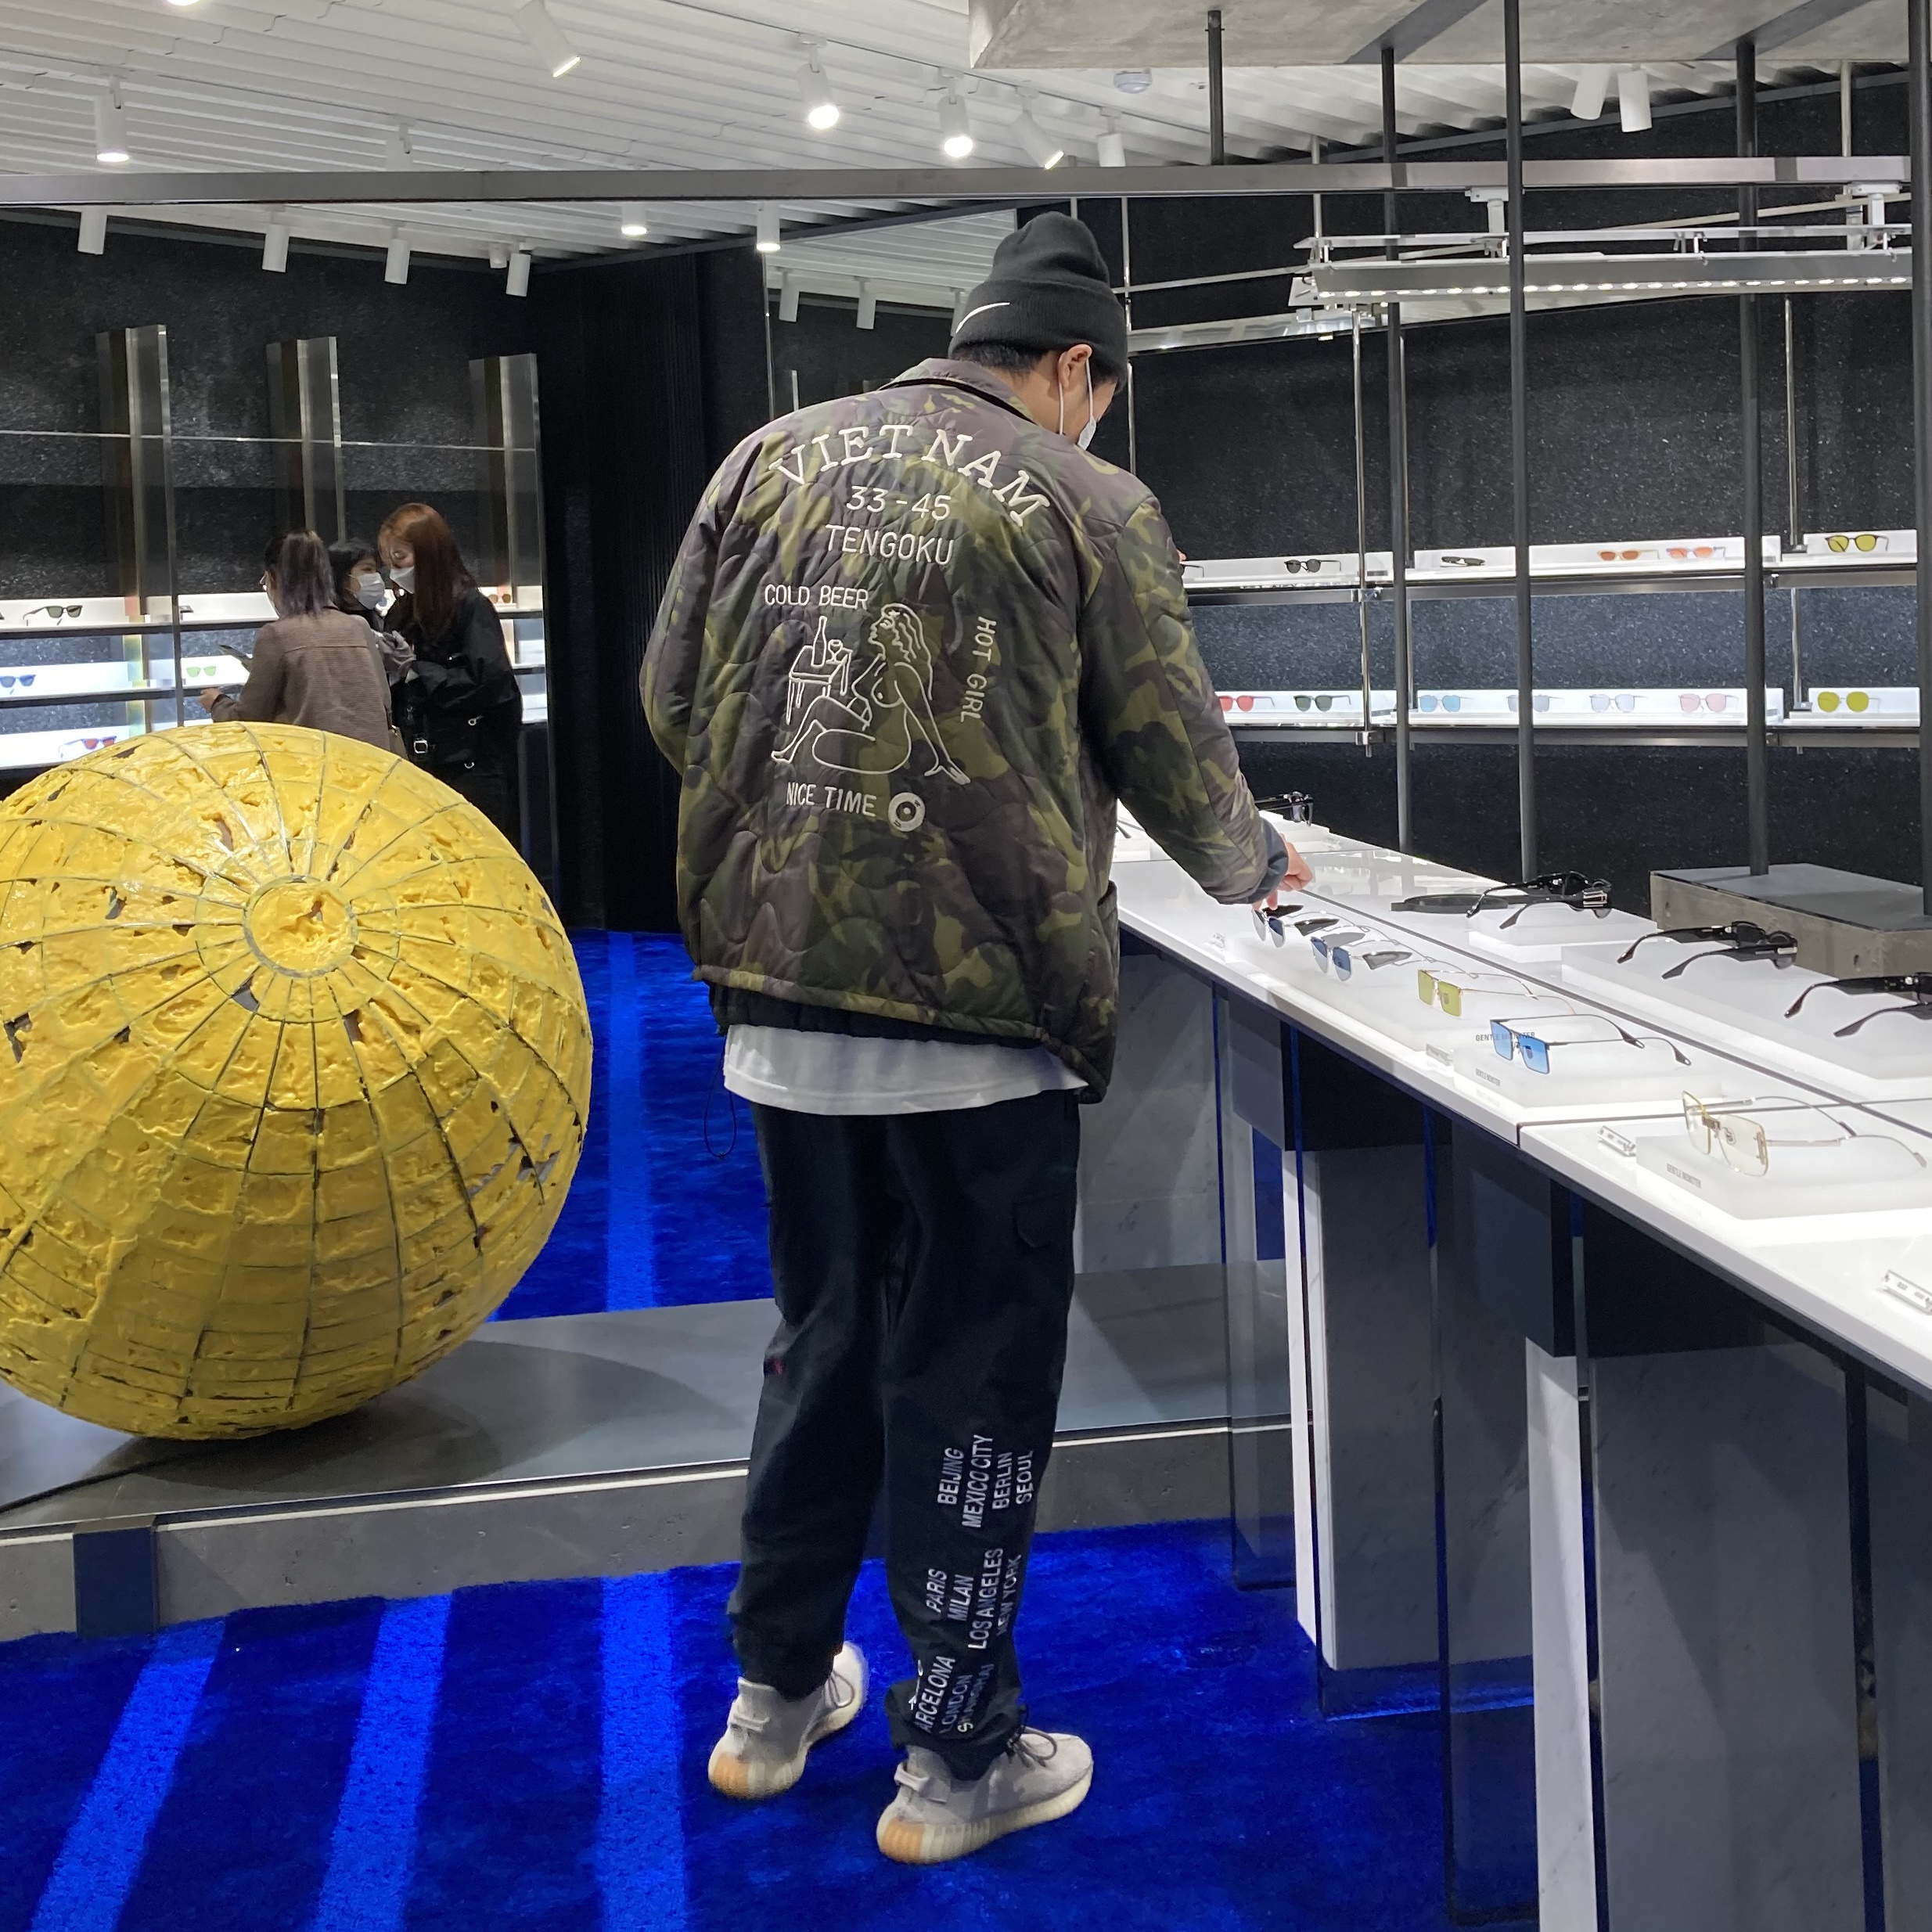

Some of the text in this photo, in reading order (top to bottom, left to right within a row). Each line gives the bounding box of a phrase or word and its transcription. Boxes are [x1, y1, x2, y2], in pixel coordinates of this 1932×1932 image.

[846, 486, 952, 521] 33-45
[825, 524, 955, 566] TENGOKU
[765, 584, 869, 610] COLD BEER
[960, 616, 997, 723] HOT GIRL
[786, 782, 877, 817] NICE TIME
[1475, 1031, 1536, 1042] GENTLE MNTER
[937, 1448, 964, 1505] BEIJING
[962, 1434, 993, 1527] MEXICO CITY
[992, 1452, 1013, 1509] BERLIN
[1016, 1450, 1034, 1505] SEOUL
[926, 1568, 948, 1613] PARIS
[947, 1574, 974, 1621] MILAN
[967, 1548, 1003, 1650] LOS ANGELES
[914, 1655, 956, 1733] ARCELONA
